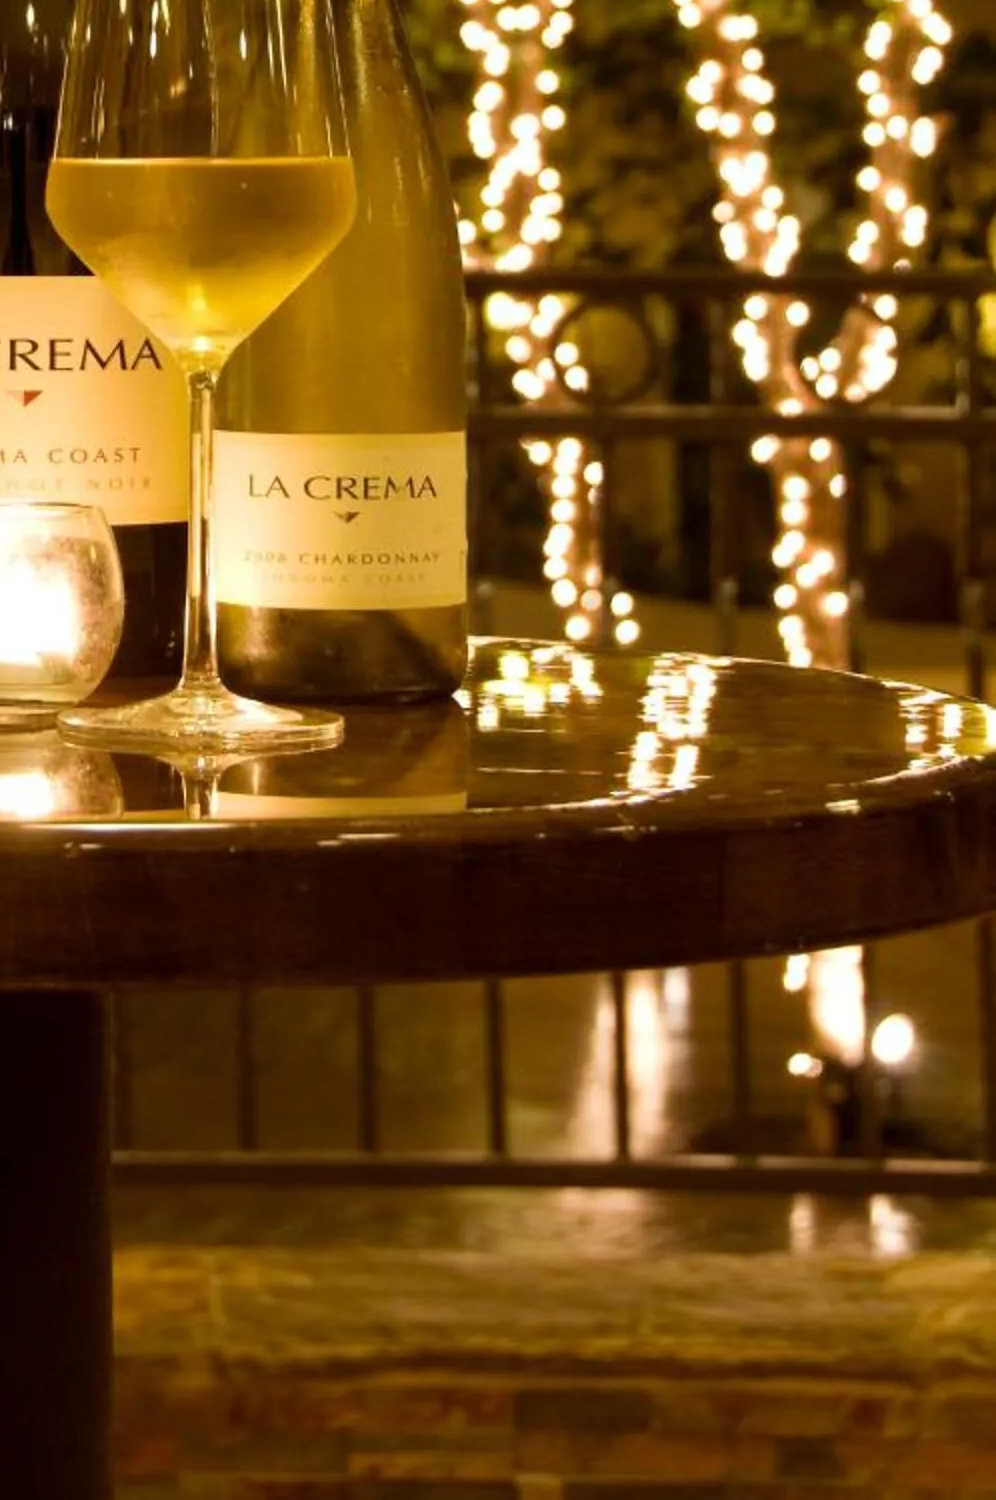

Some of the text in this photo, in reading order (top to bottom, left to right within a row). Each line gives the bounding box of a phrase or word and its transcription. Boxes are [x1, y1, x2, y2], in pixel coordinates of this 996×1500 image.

[47, 447, 142, 464] COAST
[248, 474, 438, 501] LA CREMA
[298, 552, 441, 567] CHARDONNAY
